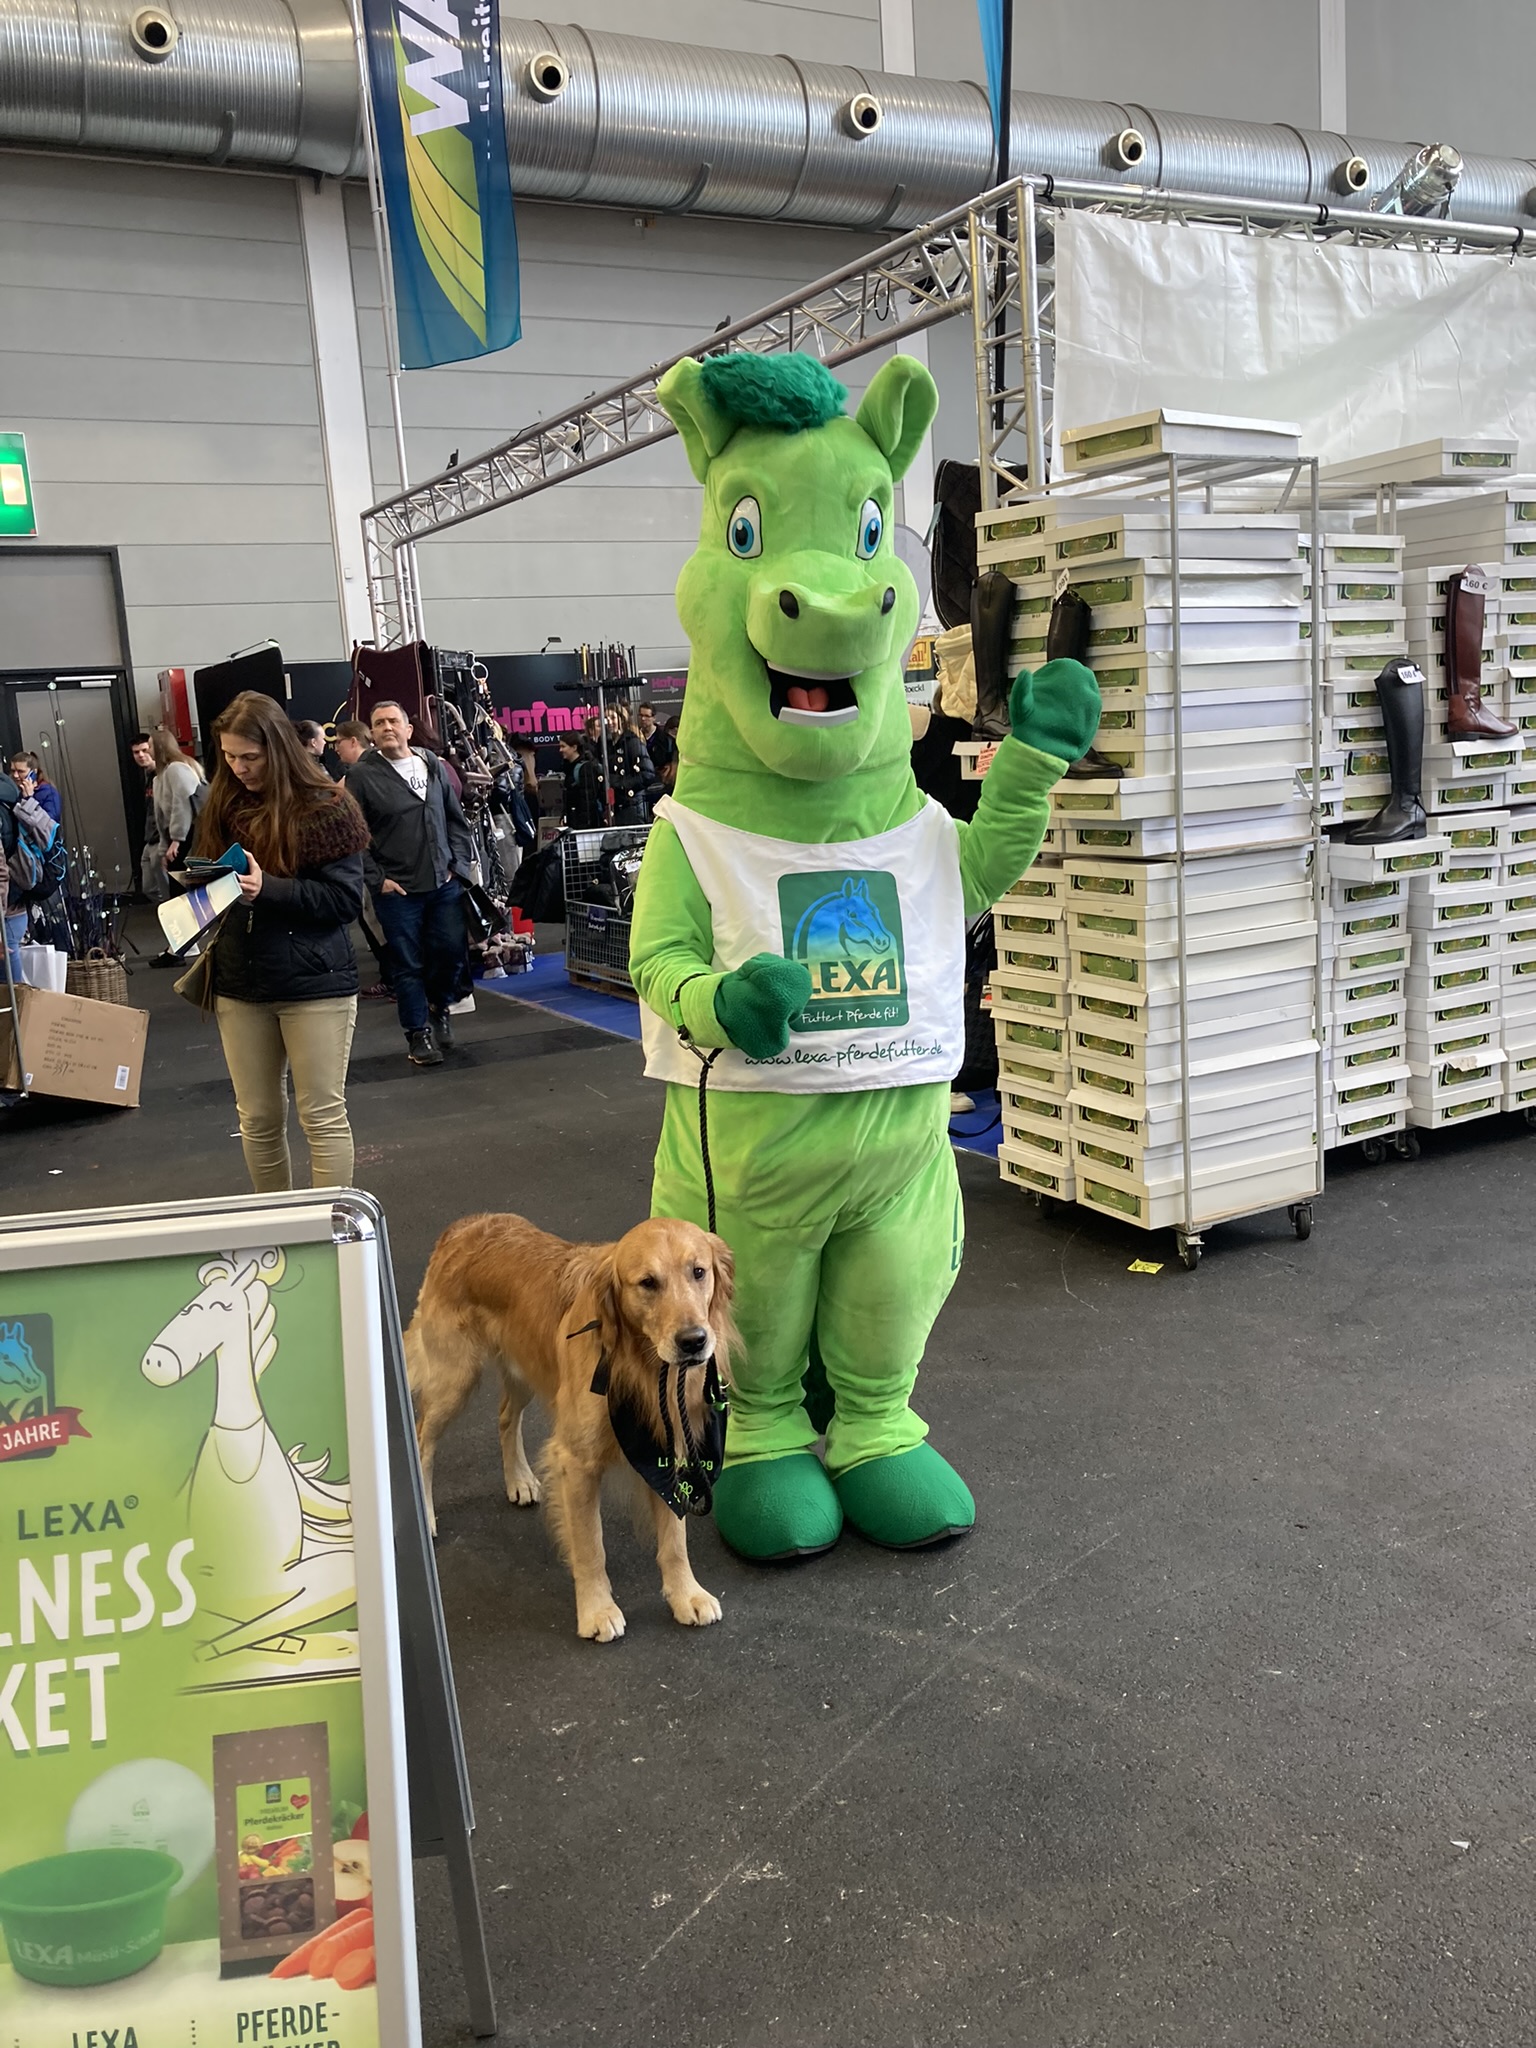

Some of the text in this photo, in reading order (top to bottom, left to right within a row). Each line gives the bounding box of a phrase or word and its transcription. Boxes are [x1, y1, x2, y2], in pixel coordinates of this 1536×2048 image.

[1464, 578, 1488, 590] 160 €
[534, 735, 554, 743] BODY
[845, 1008, 882, 1023] Pferde
[884, 1006, 899, 1022] fit!
[745, 1039, 943, 1068] www.lexa-pferdefutter.de
[3, 1421, 61, 1450] JAHRE
[0, 1537, 197, 1648] NESS
[237, 2001, 340, 2044] PFERDE-
